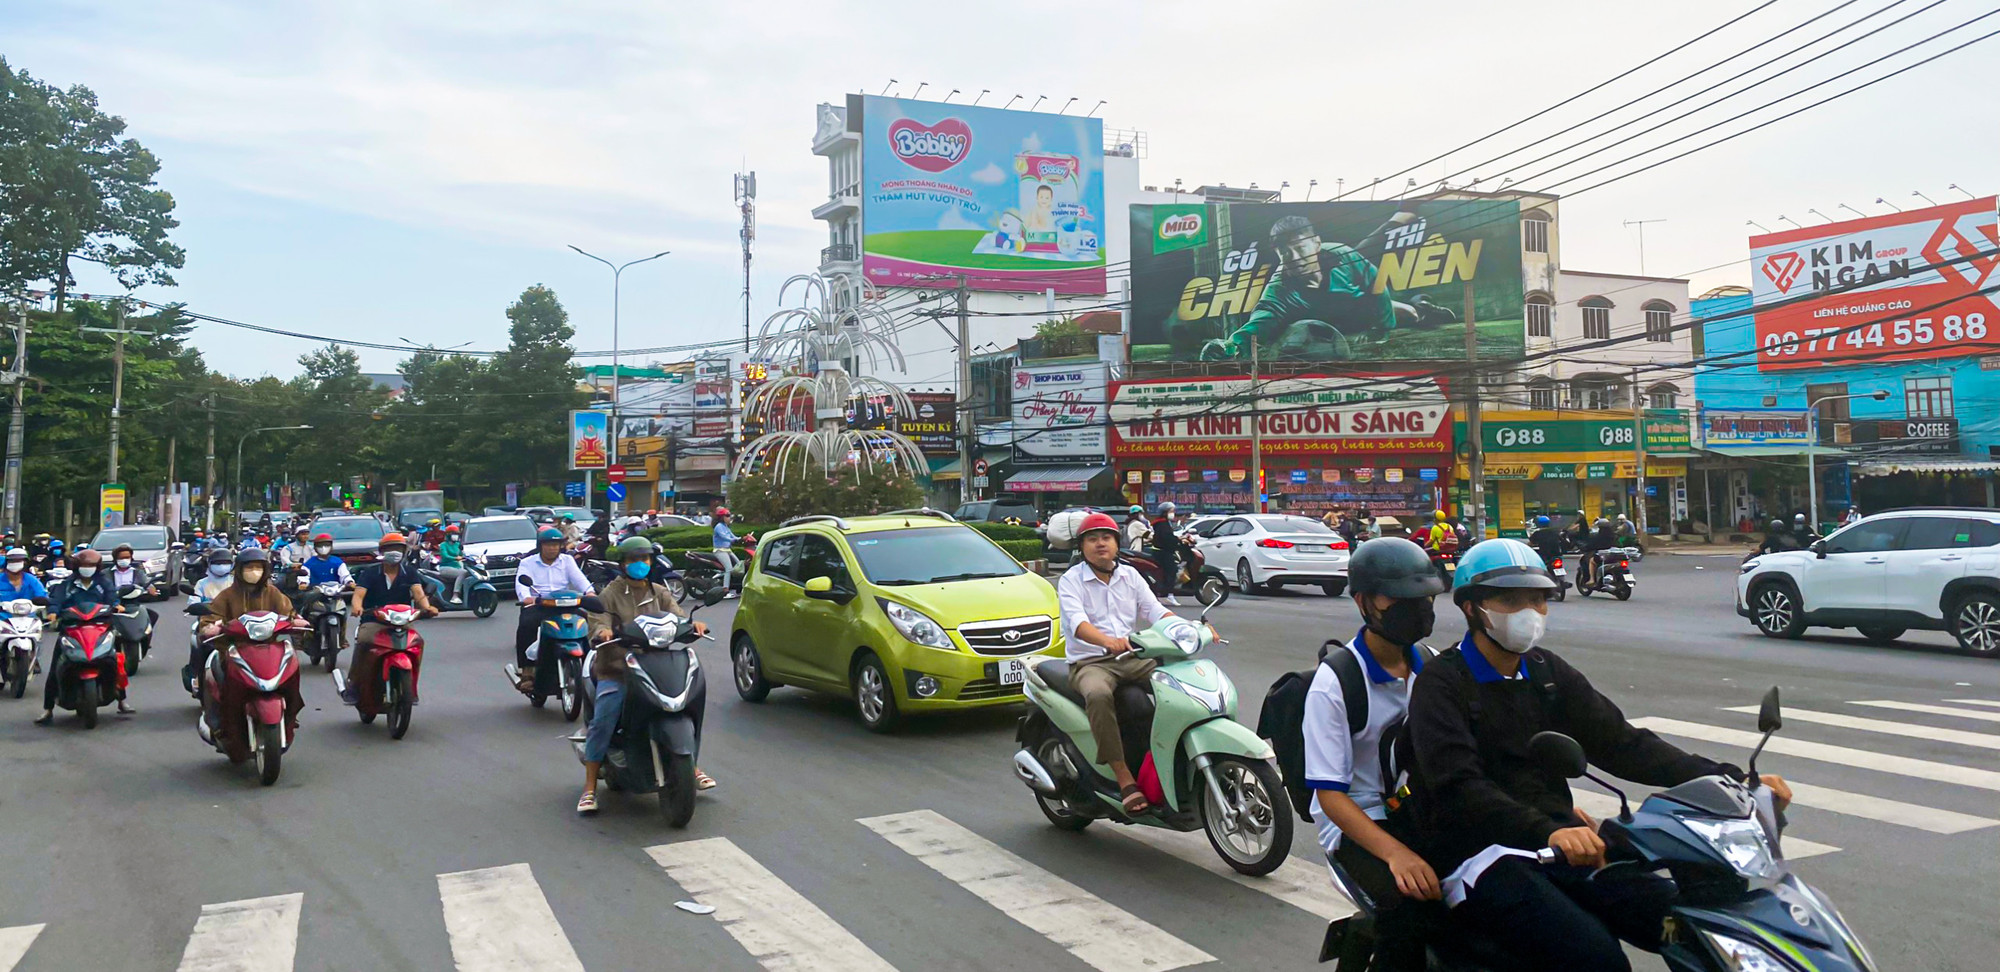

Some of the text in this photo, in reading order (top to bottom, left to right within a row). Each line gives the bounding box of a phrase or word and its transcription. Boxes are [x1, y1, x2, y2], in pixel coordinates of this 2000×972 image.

[895, 130, 965, 161] Bobby
[1165, 220, 1198, 234] MILO
[1385, 216, 1426, 250] THÌ
[1223, 241, 1258, 272] CÓ
[1372, 232, 1483, 294] NÊN
[1810, 240, 1908, 268] KIM GROUP
[1813, 299, 1912, 318] LIÊN HỆ QUẢNG CÁO
[1764, 313, 1988, 357] 09 77 44 55 88
[1034, 374, 1052, 382] SHOP
[1052, 374, 1066, 382] HOA
[1058, 391, 1098, 425] Nhung
[1254, 409, 1341, 434] NGUỒN
[1351, 405, 1424, 433] SÁNG
[1496, 427, 1545, 447] F88
[1599, 426, 1633, 446] F88
[1907, 423, 1950, 437] COFFEE
